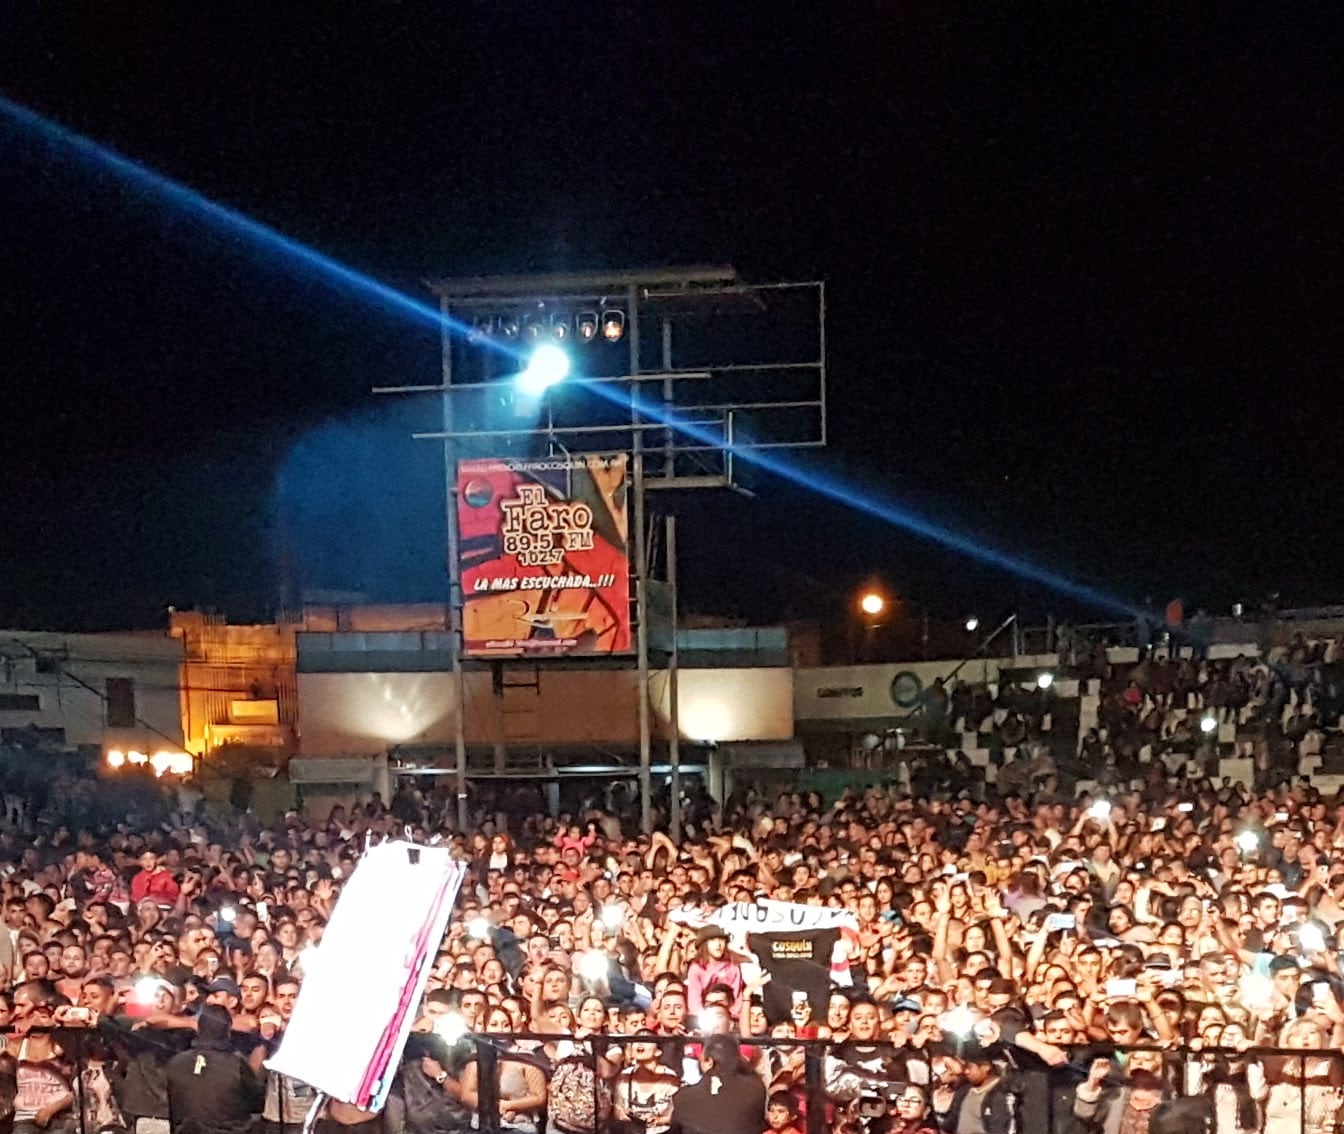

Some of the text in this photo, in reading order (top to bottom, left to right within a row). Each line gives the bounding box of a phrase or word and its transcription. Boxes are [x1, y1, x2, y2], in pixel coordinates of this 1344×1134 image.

[520, 487, 546, 506] El
[503, 504, 592, 534] Faro
[506, 532, 593, 552] 89.5 FM
[518, 550, 563, 564] 102.7
[474, 578, 489, 591] LA
[491, 577, 519, 591] MAS
